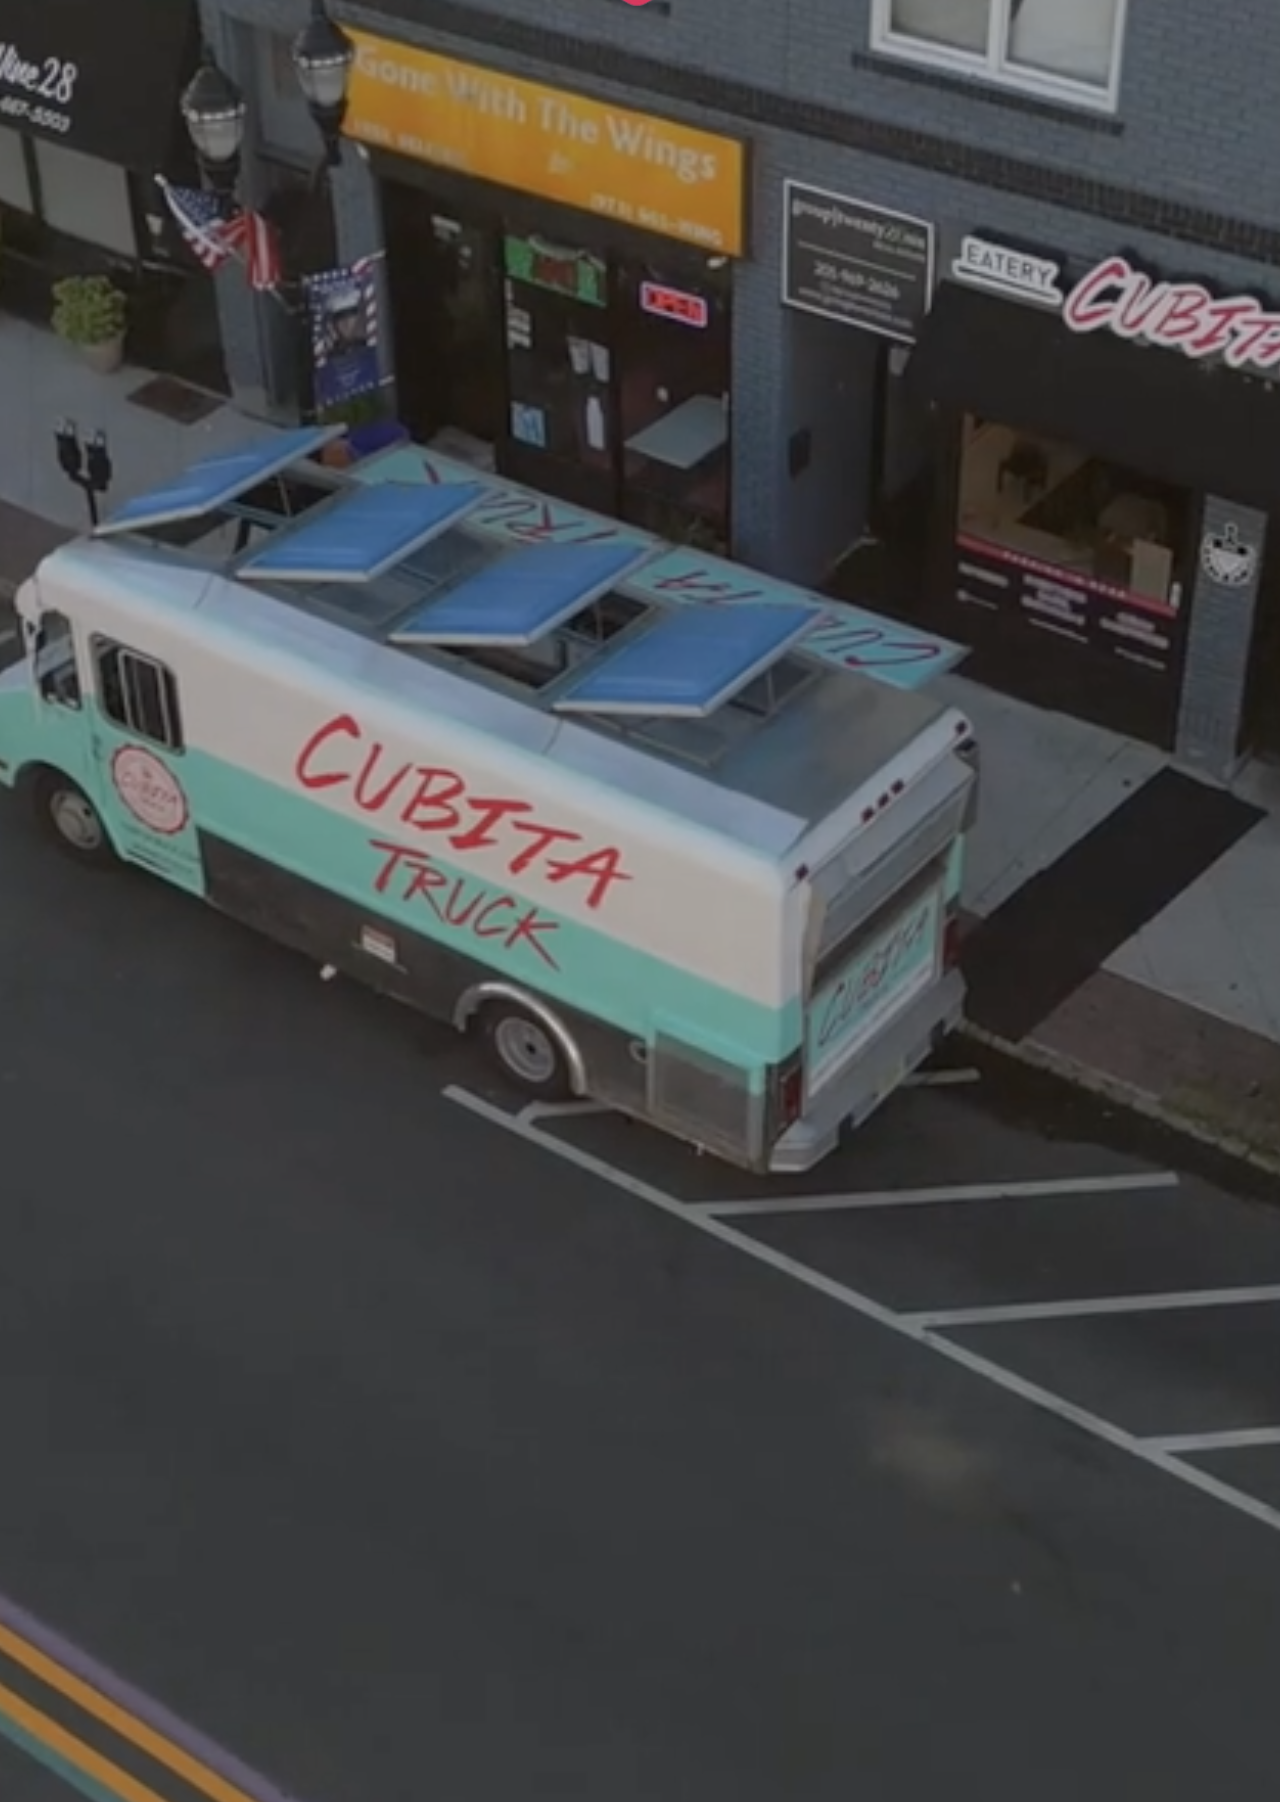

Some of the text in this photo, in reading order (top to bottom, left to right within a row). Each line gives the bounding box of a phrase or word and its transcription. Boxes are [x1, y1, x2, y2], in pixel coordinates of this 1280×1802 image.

[355, 46, 437, 96] Gone
[444, 66, 527, 124] With
[537, 97, 599, 145] The
[605, 113, 718, 184] Wings
[967, 243, 1053, 286] EATERY
[294, 713, 634, 909] CUBITA
[368, 838, 561, 972] TRUCK
